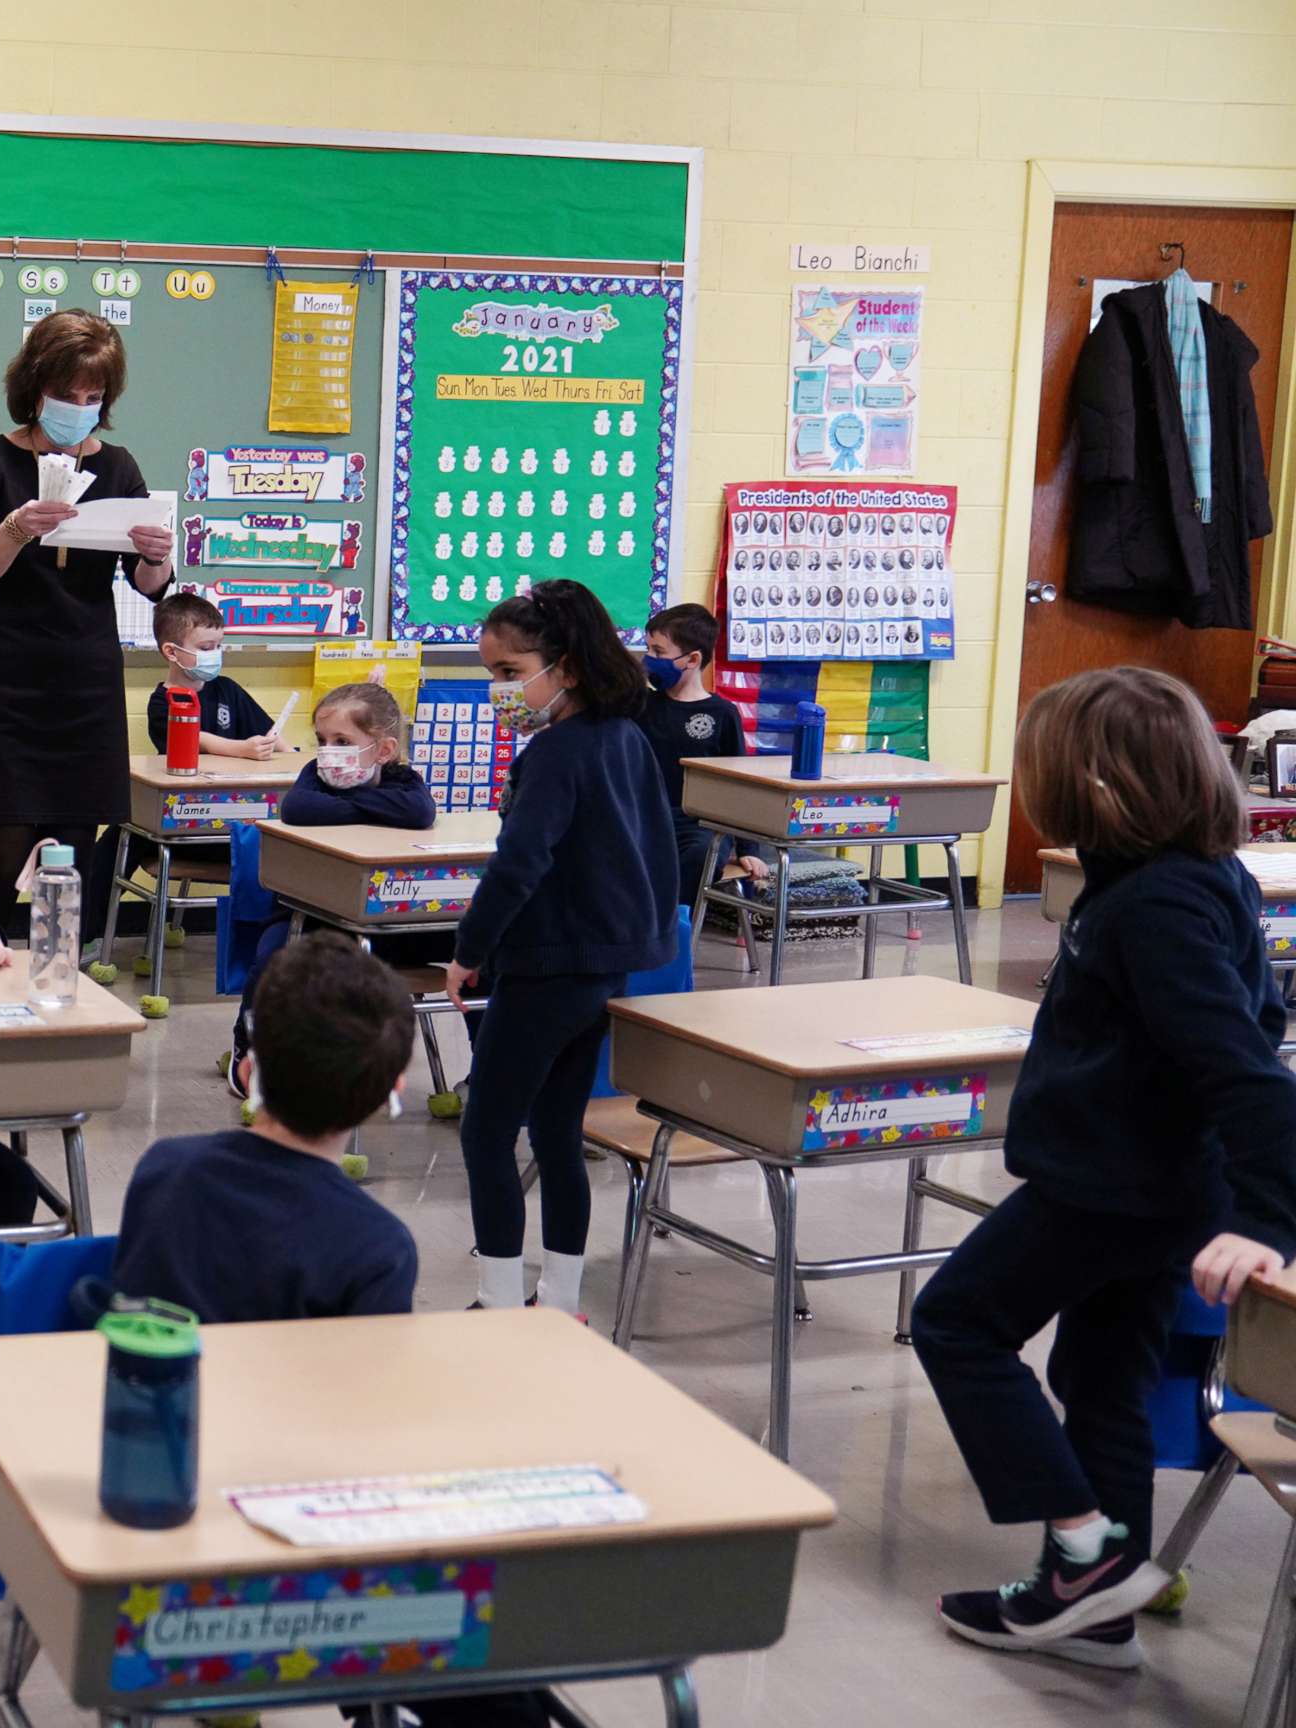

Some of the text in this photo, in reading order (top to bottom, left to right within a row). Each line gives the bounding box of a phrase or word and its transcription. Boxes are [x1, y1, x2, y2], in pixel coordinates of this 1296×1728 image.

[796, 245, 919, 271] Leo Bianchi
[27, 304, 53, 316] see
[103, 303, 128, 320] the
[302, 296, 341, 313] Money
[857, 299, 917, 316] Student
[480, 307, 593, 333] January
[855, 317, 866, 333] of
[500, 345, 573, 373] 2021
[437, 376, 642, 400] Sun Mon Tues Wed Thurs Fri Sat
[230, 447, 326, 464] Yesterday was
[227, 463, 324, 503] Tuesday
[739, 490, 947, 508] Presidents of the United States
[247, 514, 288, 531] Today
[209, 532, 338, 573] Wednesday
[220, 582, 330, 595] Tomorrow will be
[218, 596, 333, 632] Thursday
[442, 708, 449, 717] 2
[461, 708, 468, 717] 3
[482, 707, 490, 717] 4
[418, 727, 510, 738] 11 12 13 14 15
[417, 749, 510, 759] 21 22 23 24 25
[433, 769, 446, 779] 32
[456, 769, 469, 779] 33
[475, 769, 487, 779] 34
[495, 769, 508, 779] 35
[432, 790, 445, 800] 42
[453, 790, 467, 800] 43
[474, 790, 488, 800] 44
[175, 800, 211, 816] James
[801, 803, 824, 821] Leo
[382, 878, 421, 900] Molly
[825, 1103, 888, 1124] Adhira
[151, 1600, 367, 1648] Christopher
